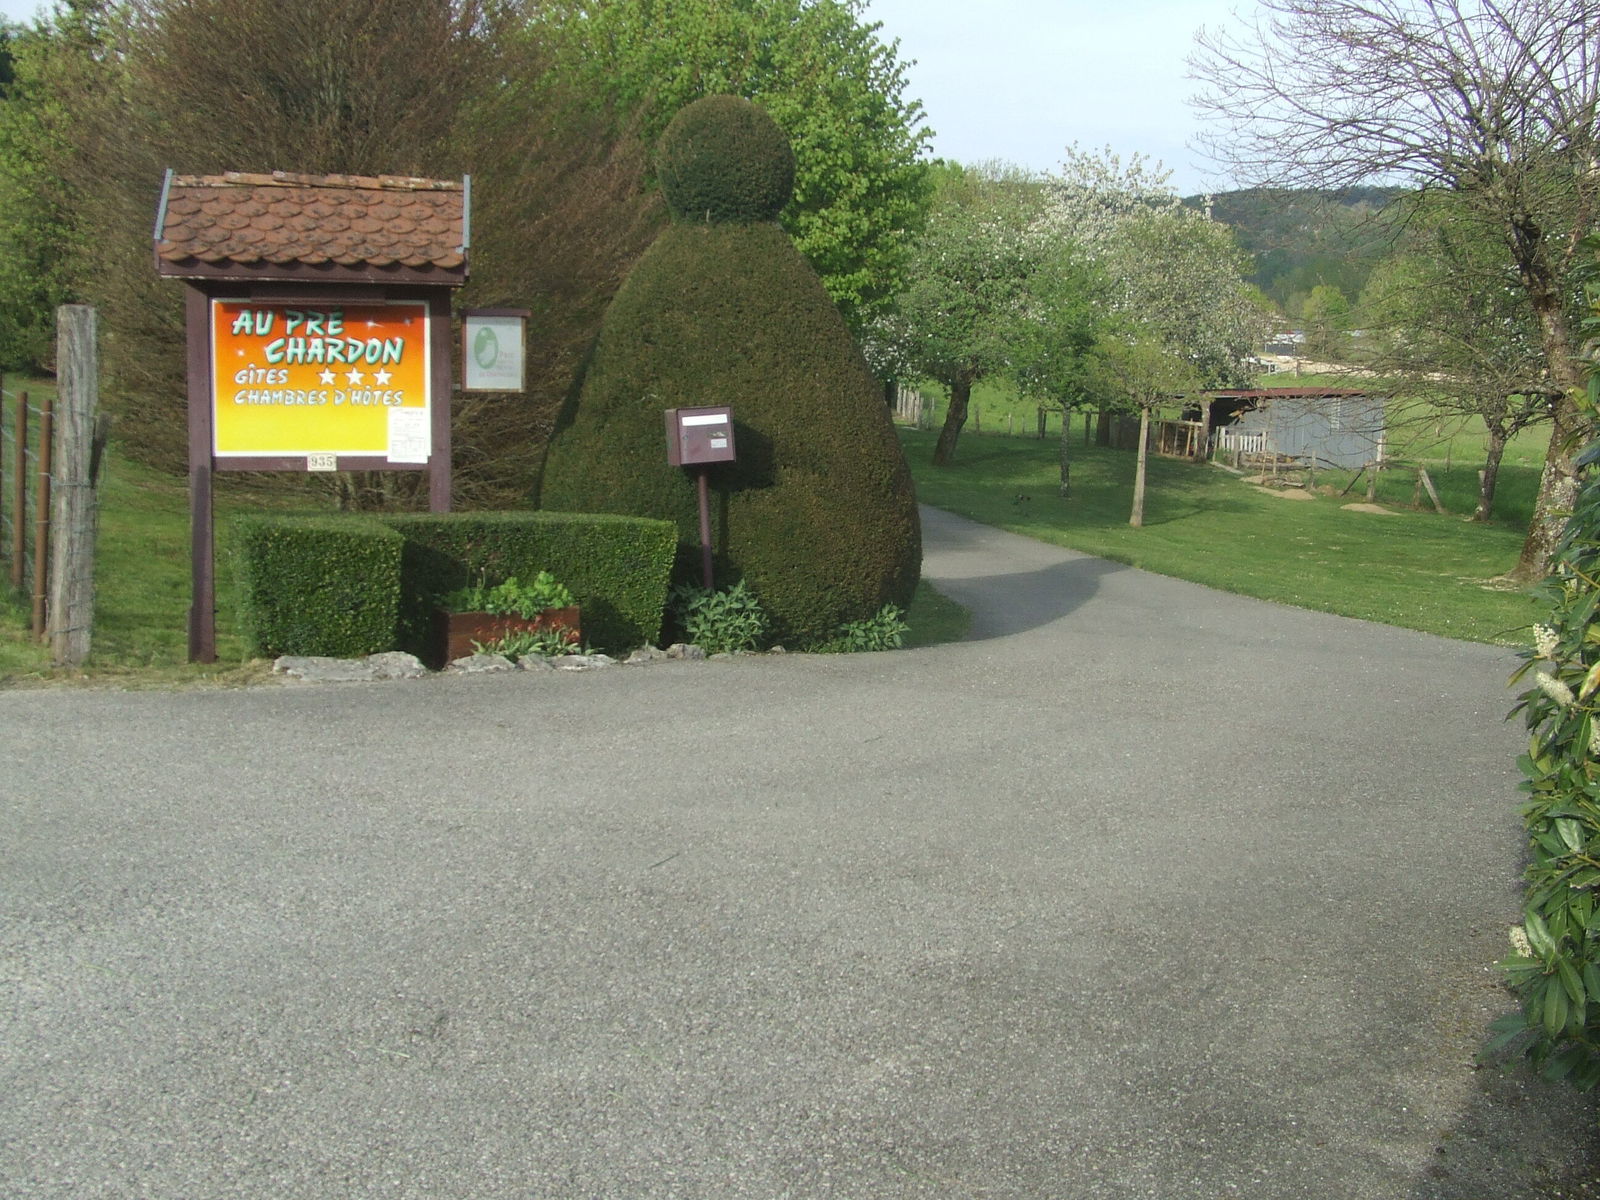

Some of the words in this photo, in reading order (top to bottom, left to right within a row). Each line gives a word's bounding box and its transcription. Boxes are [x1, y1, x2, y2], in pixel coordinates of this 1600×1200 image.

[232, 310, 274, 336] AU
[264, 337, 404, 364] CHARDON
[234, 390, 327, 405] CHAMBRES
[311, 457, 333, 467] 935
